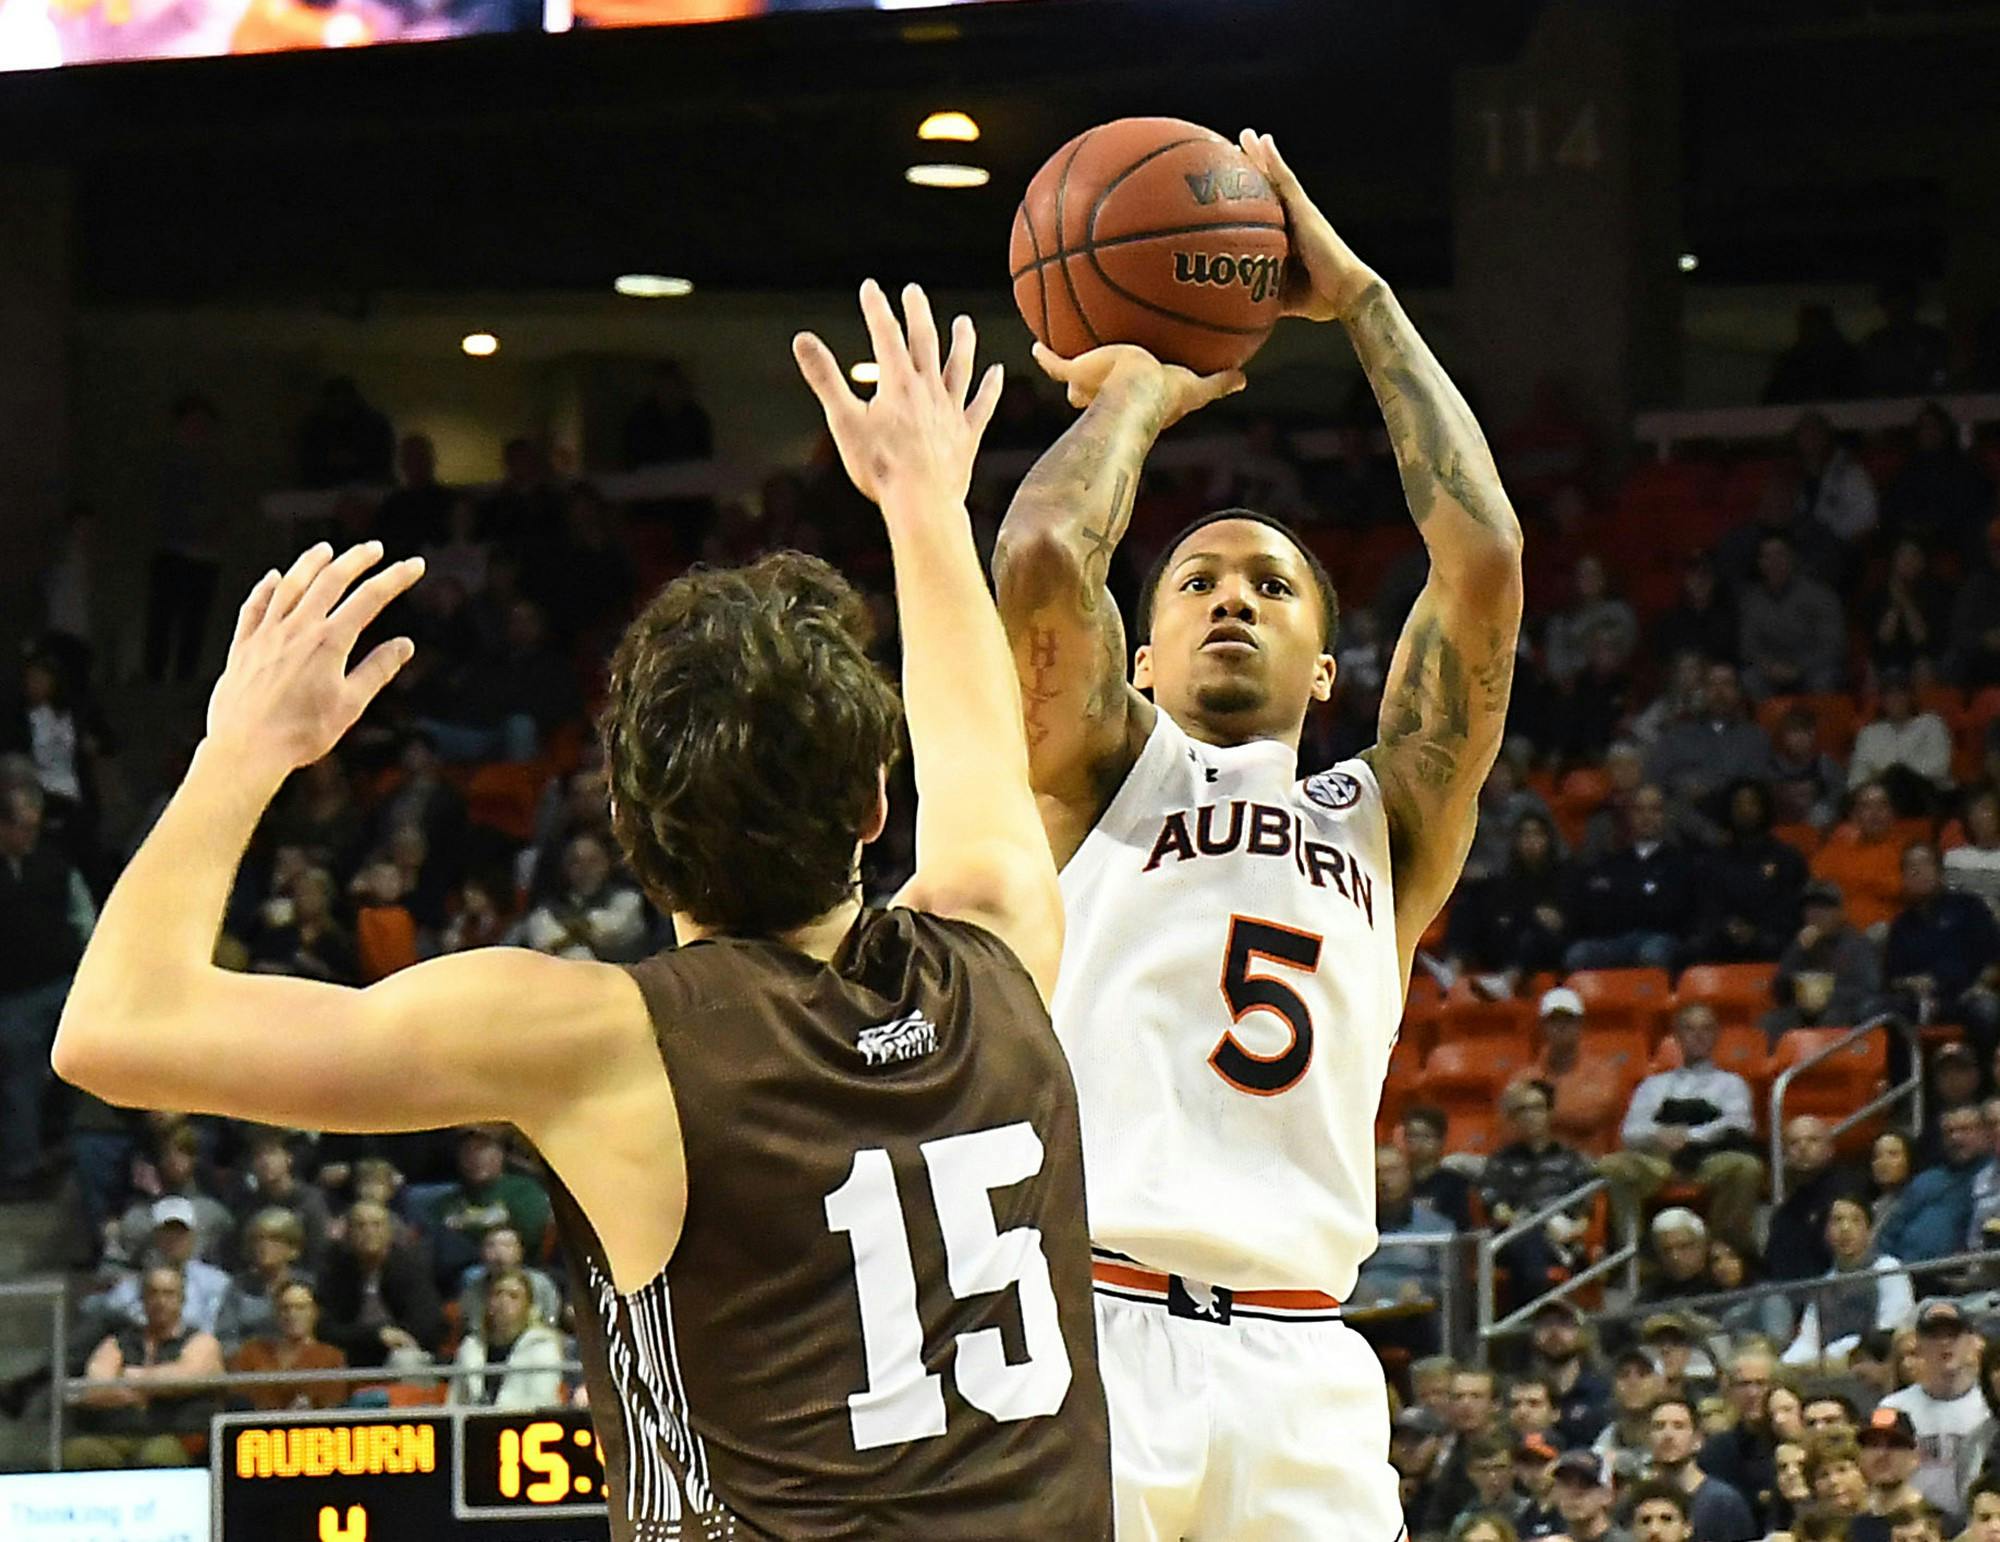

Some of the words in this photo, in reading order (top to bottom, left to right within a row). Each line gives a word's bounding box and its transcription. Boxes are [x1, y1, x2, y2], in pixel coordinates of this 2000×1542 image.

[1173, 252, 1279, 303] ilson
[1207, 913, 1324, 1097] 5
[824, 1121, 1073, 1451] 15
[236, 1424, 435, 1478] AUBURN
[500, 1422, 609, 1503] 15:
